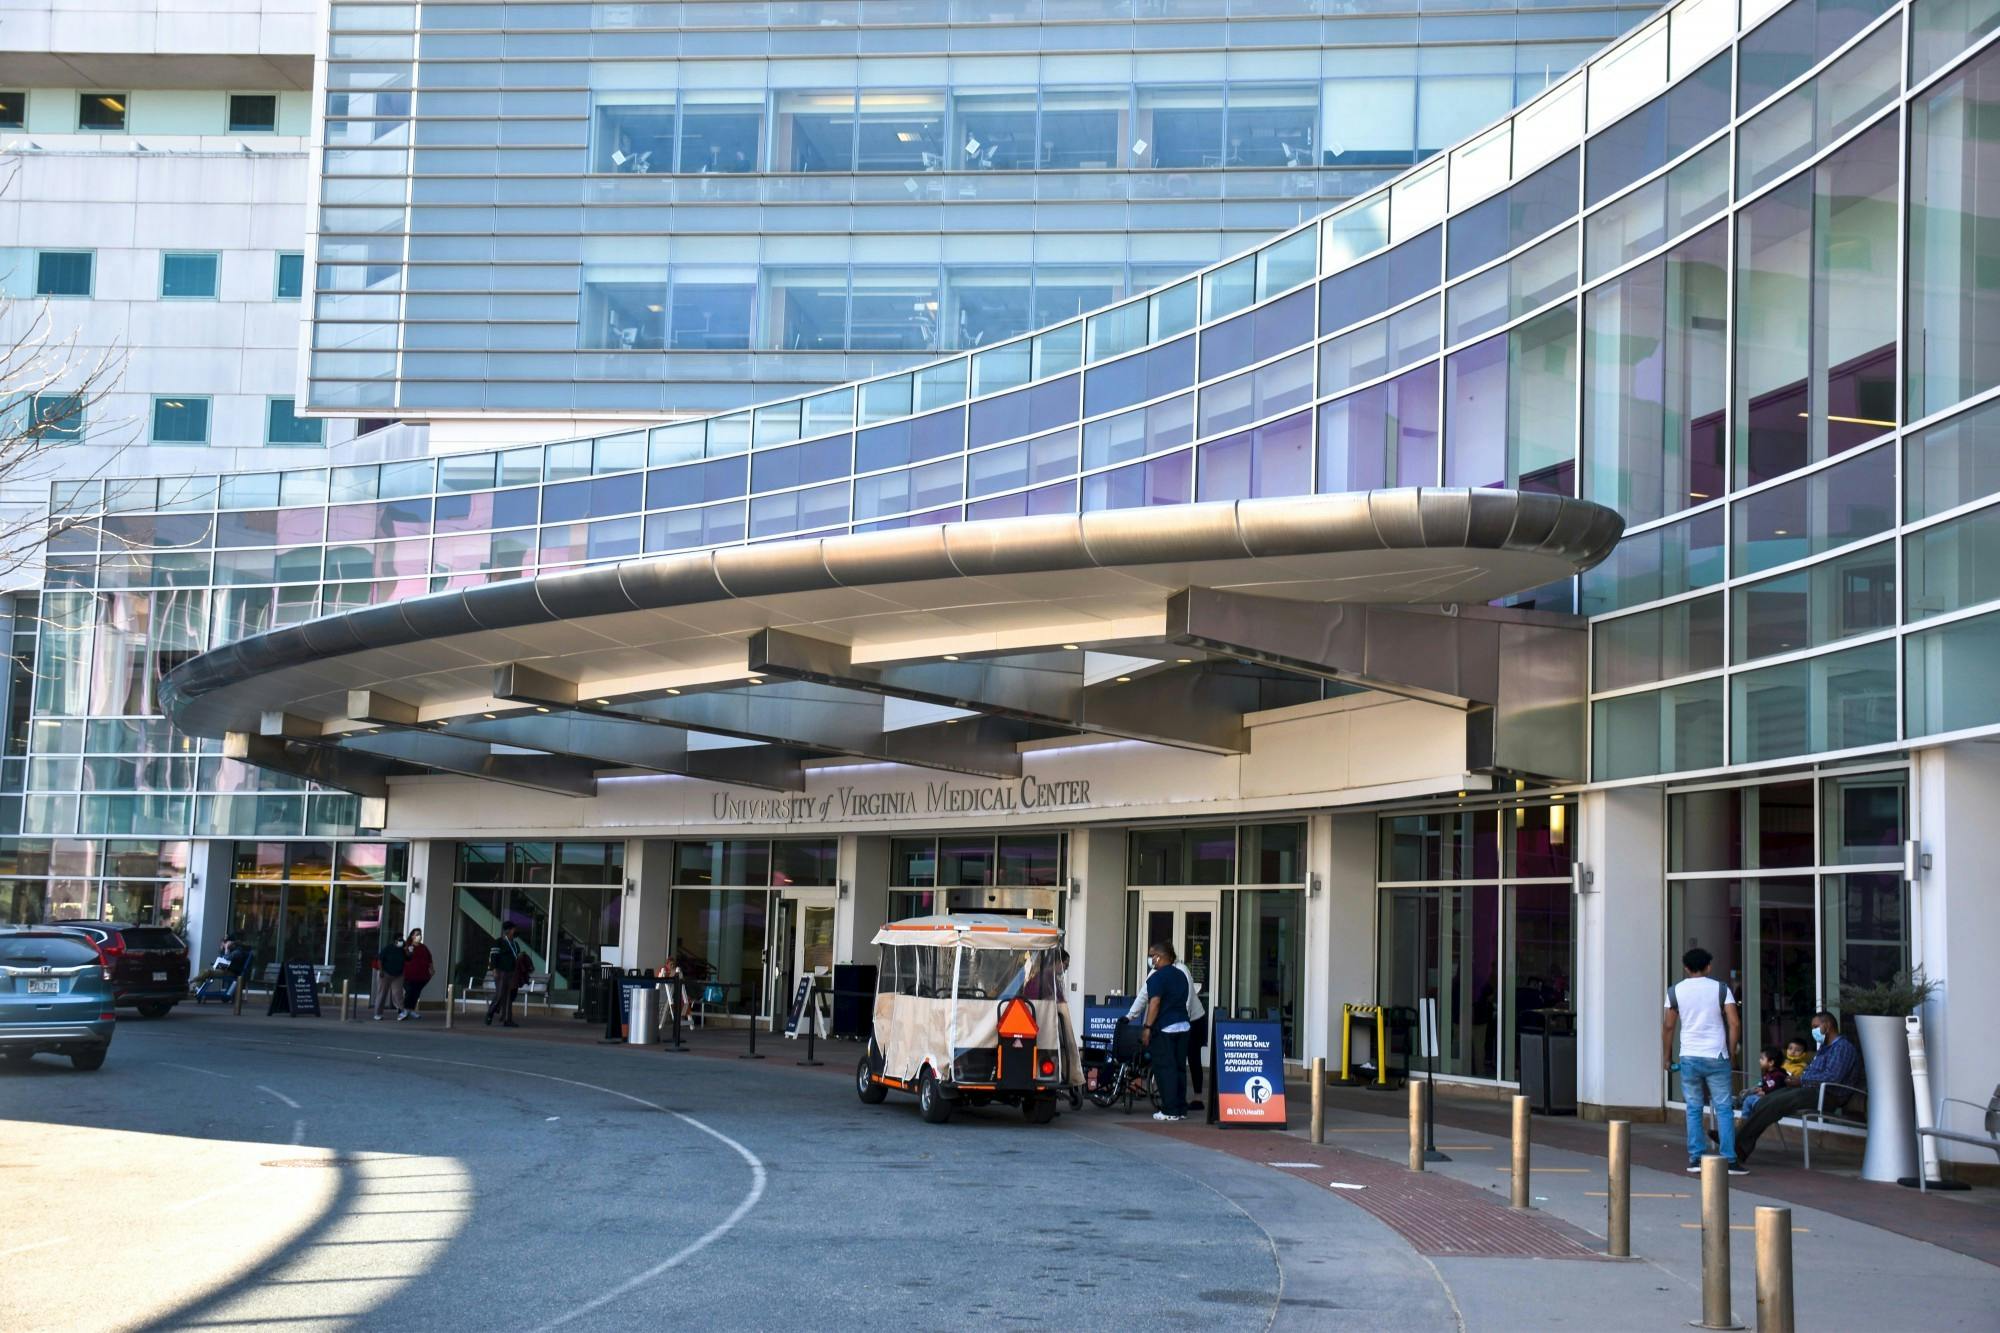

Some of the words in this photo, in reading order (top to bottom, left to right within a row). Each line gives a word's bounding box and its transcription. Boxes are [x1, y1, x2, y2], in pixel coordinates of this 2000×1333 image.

[712, 791, 816, 820] UNIVERSITY
[818, 794, 834, 822] of
[838, 786, 917, 816] VIRGINIA
[924, 780, 1017, 812] MEDICAL
[1020, 775, 1090, 809] CENTER
